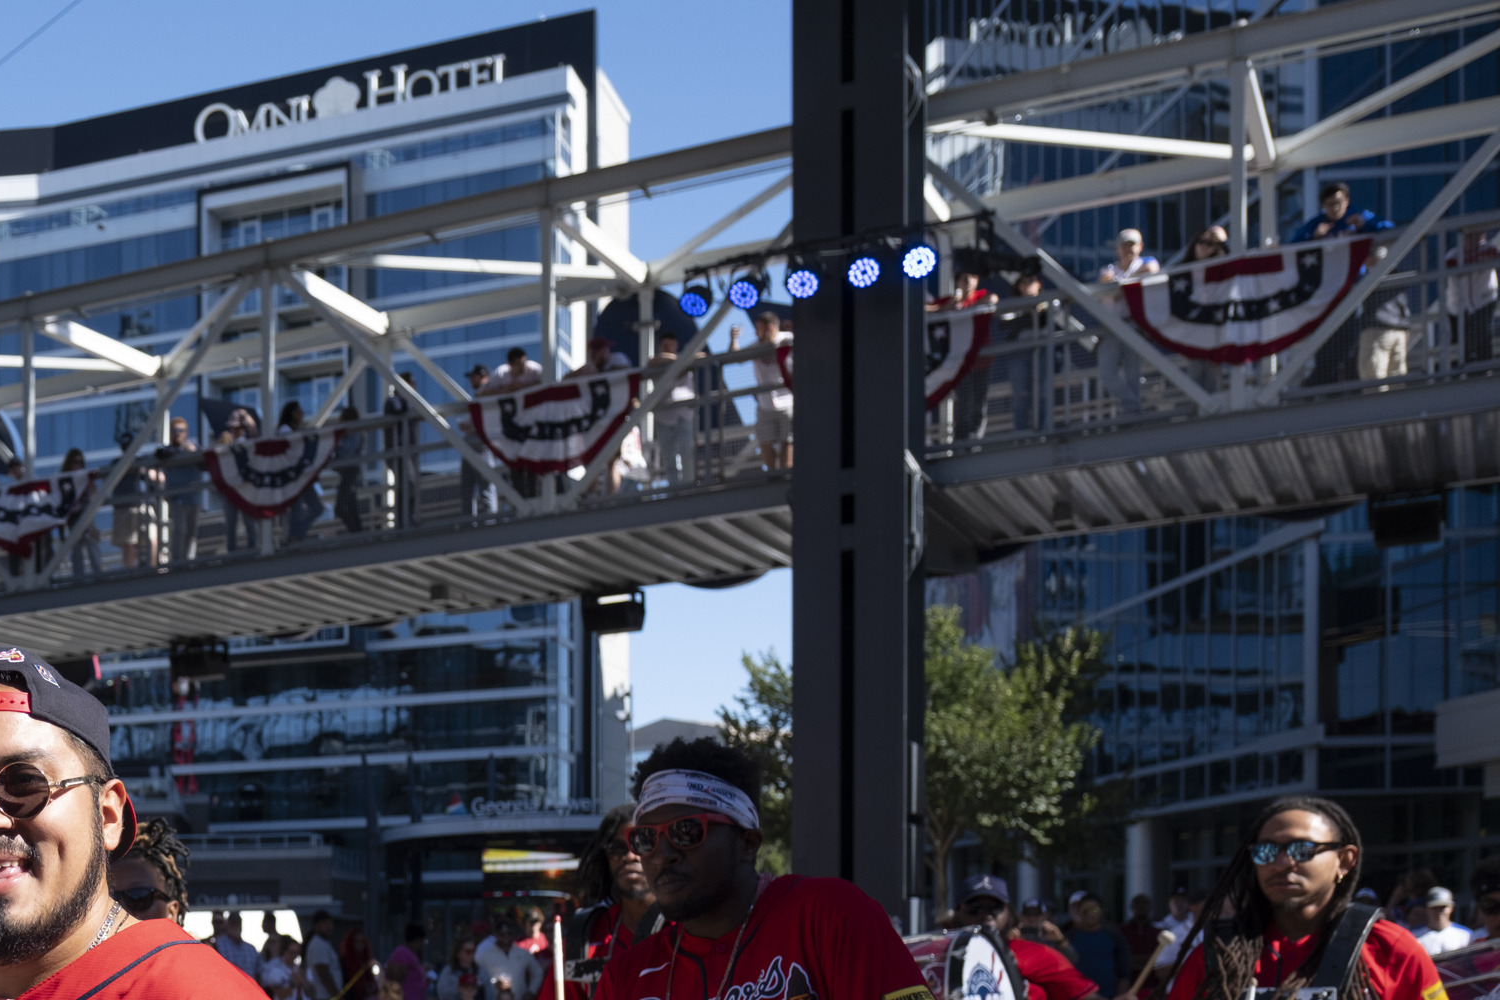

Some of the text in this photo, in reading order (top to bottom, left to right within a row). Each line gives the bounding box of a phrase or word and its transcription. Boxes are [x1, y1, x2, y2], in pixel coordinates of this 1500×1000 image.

[194, 54, 506, 144] OMNI HOTEL
[471, 796, 539, 817] Georgia
